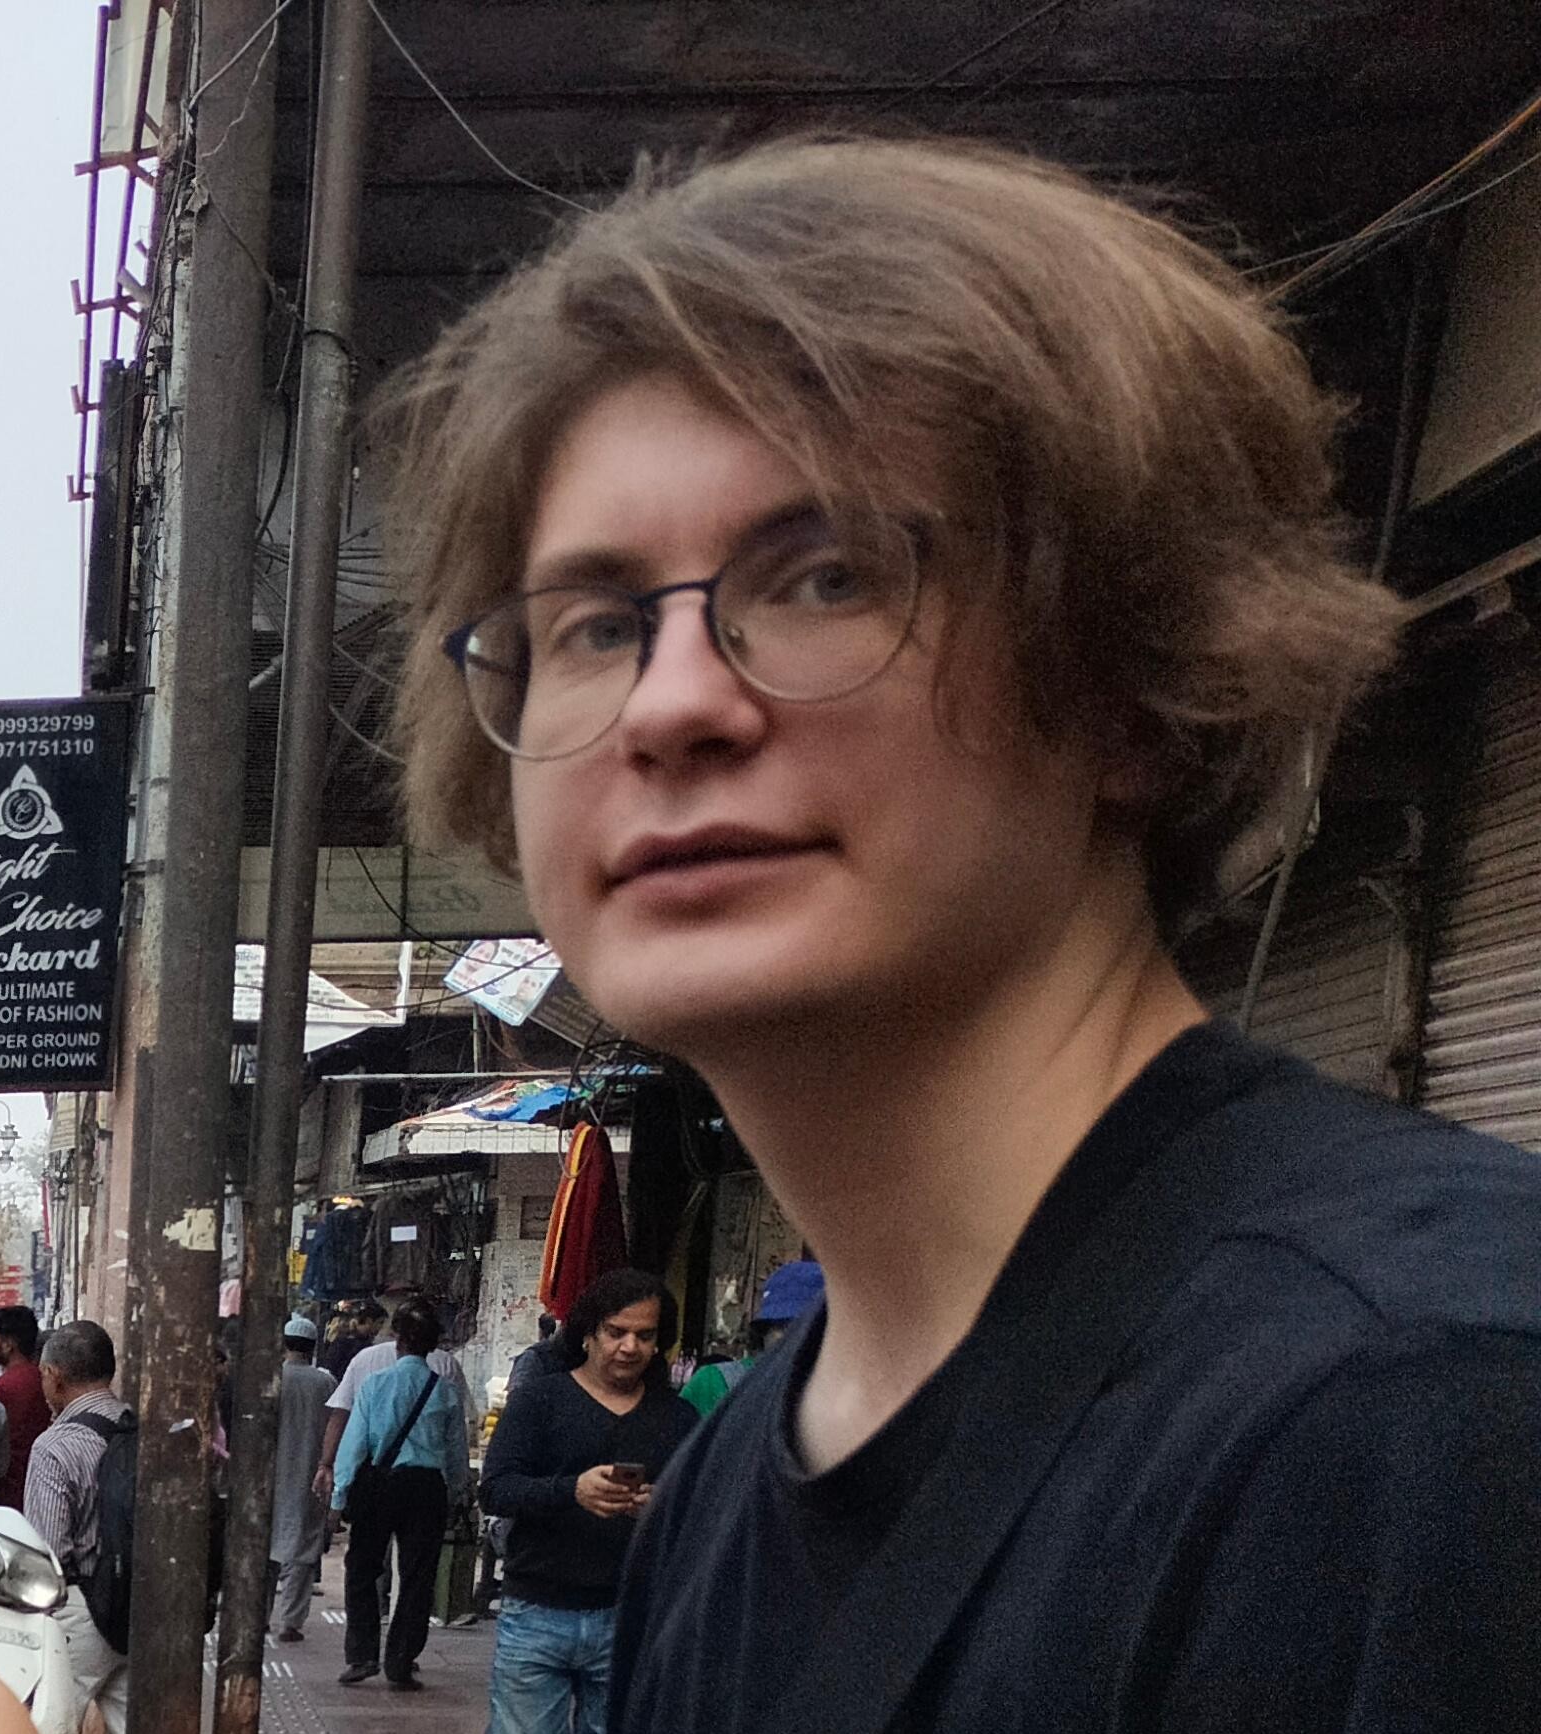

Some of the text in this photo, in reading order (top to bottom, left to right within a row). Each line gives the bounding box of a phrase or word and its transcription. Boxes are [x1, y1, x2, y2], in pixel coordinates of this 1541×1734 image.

[27, 1004, 103, 1023] FASHION
[31, 1032, 101, 1048] GROUND
[31, 1052, 97, 1068] CHOWK
